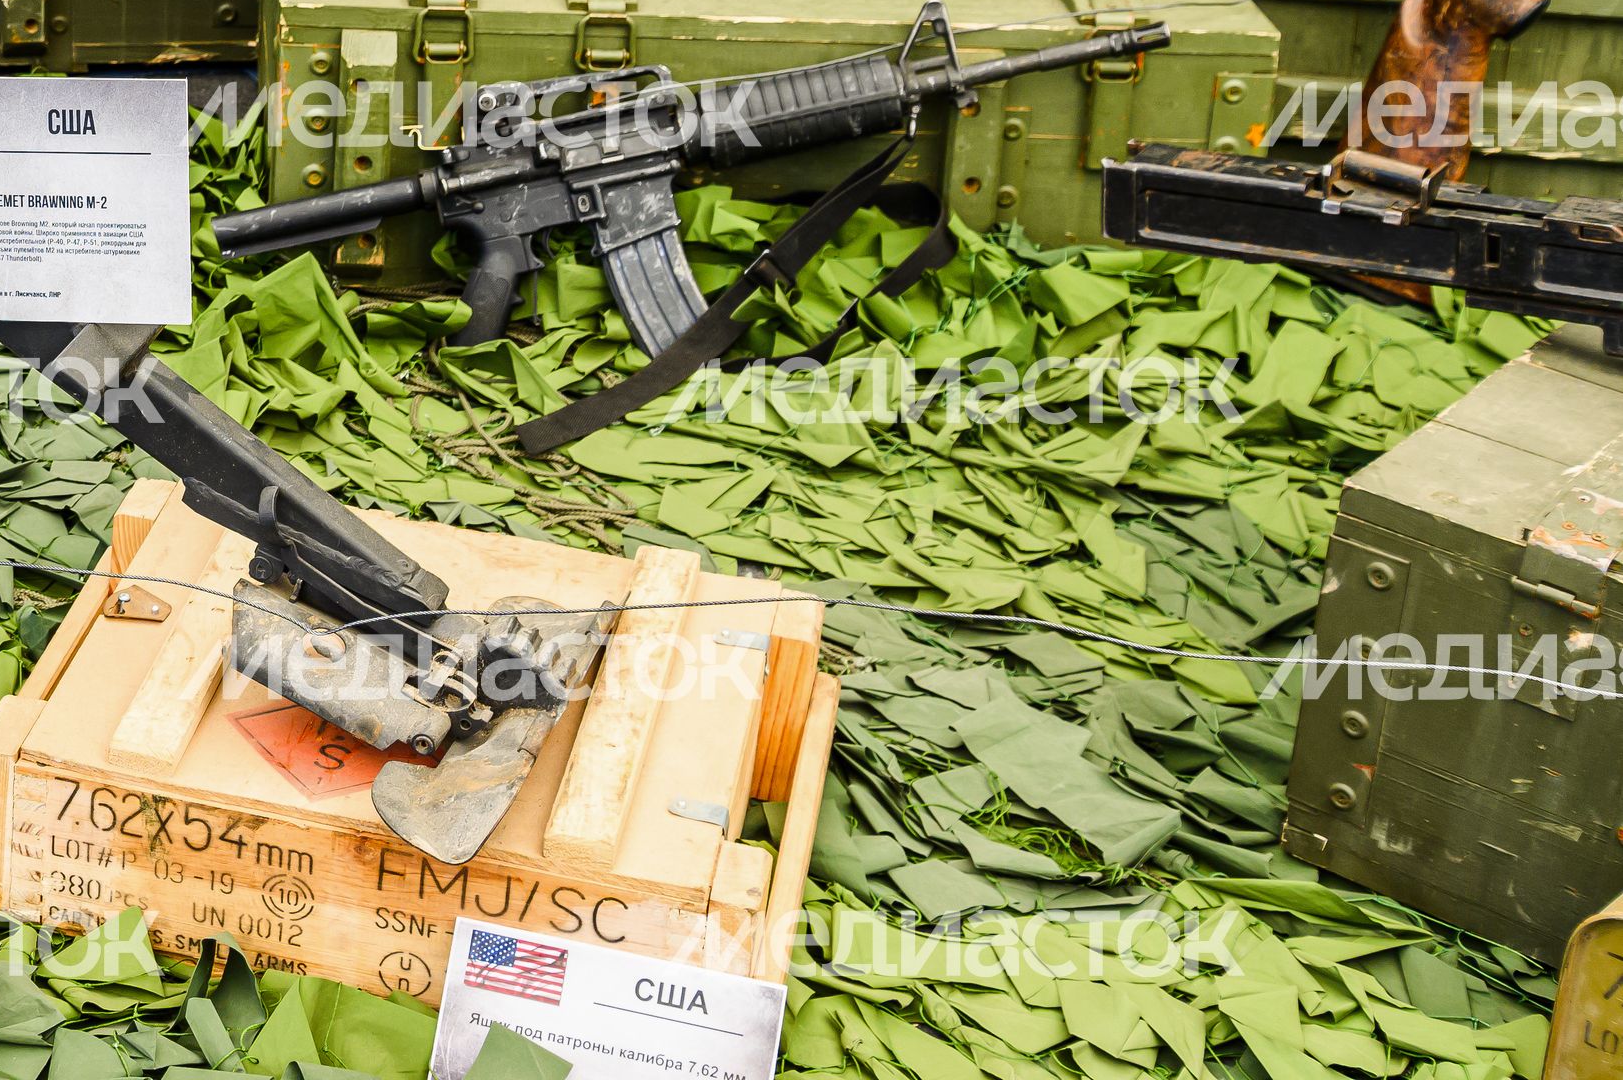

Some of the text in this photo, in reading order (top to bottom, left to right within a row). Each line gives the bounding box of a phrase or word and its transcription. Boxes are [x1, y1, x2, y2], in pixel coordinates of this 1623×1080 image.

[48, 109, 97, 135] США
[28, 195, 84, 209] BRAWNING
[51, 835, 113, 868] LOT#
[279, 888, 299, 908] 10
[377, 847, 629, 943] FMJ/SC
[193, 902, 303, 948] UN 0012
[634, 978, 709, 1015] США
[470, 1012, 510, 1031] Ящк
[515, 1025, 543, 1041] под
[547, 1032, 615, 1057] патроны
[619, 1048, 683, 1072] калибра
[688, 1060, 719, 1079] 7,62
